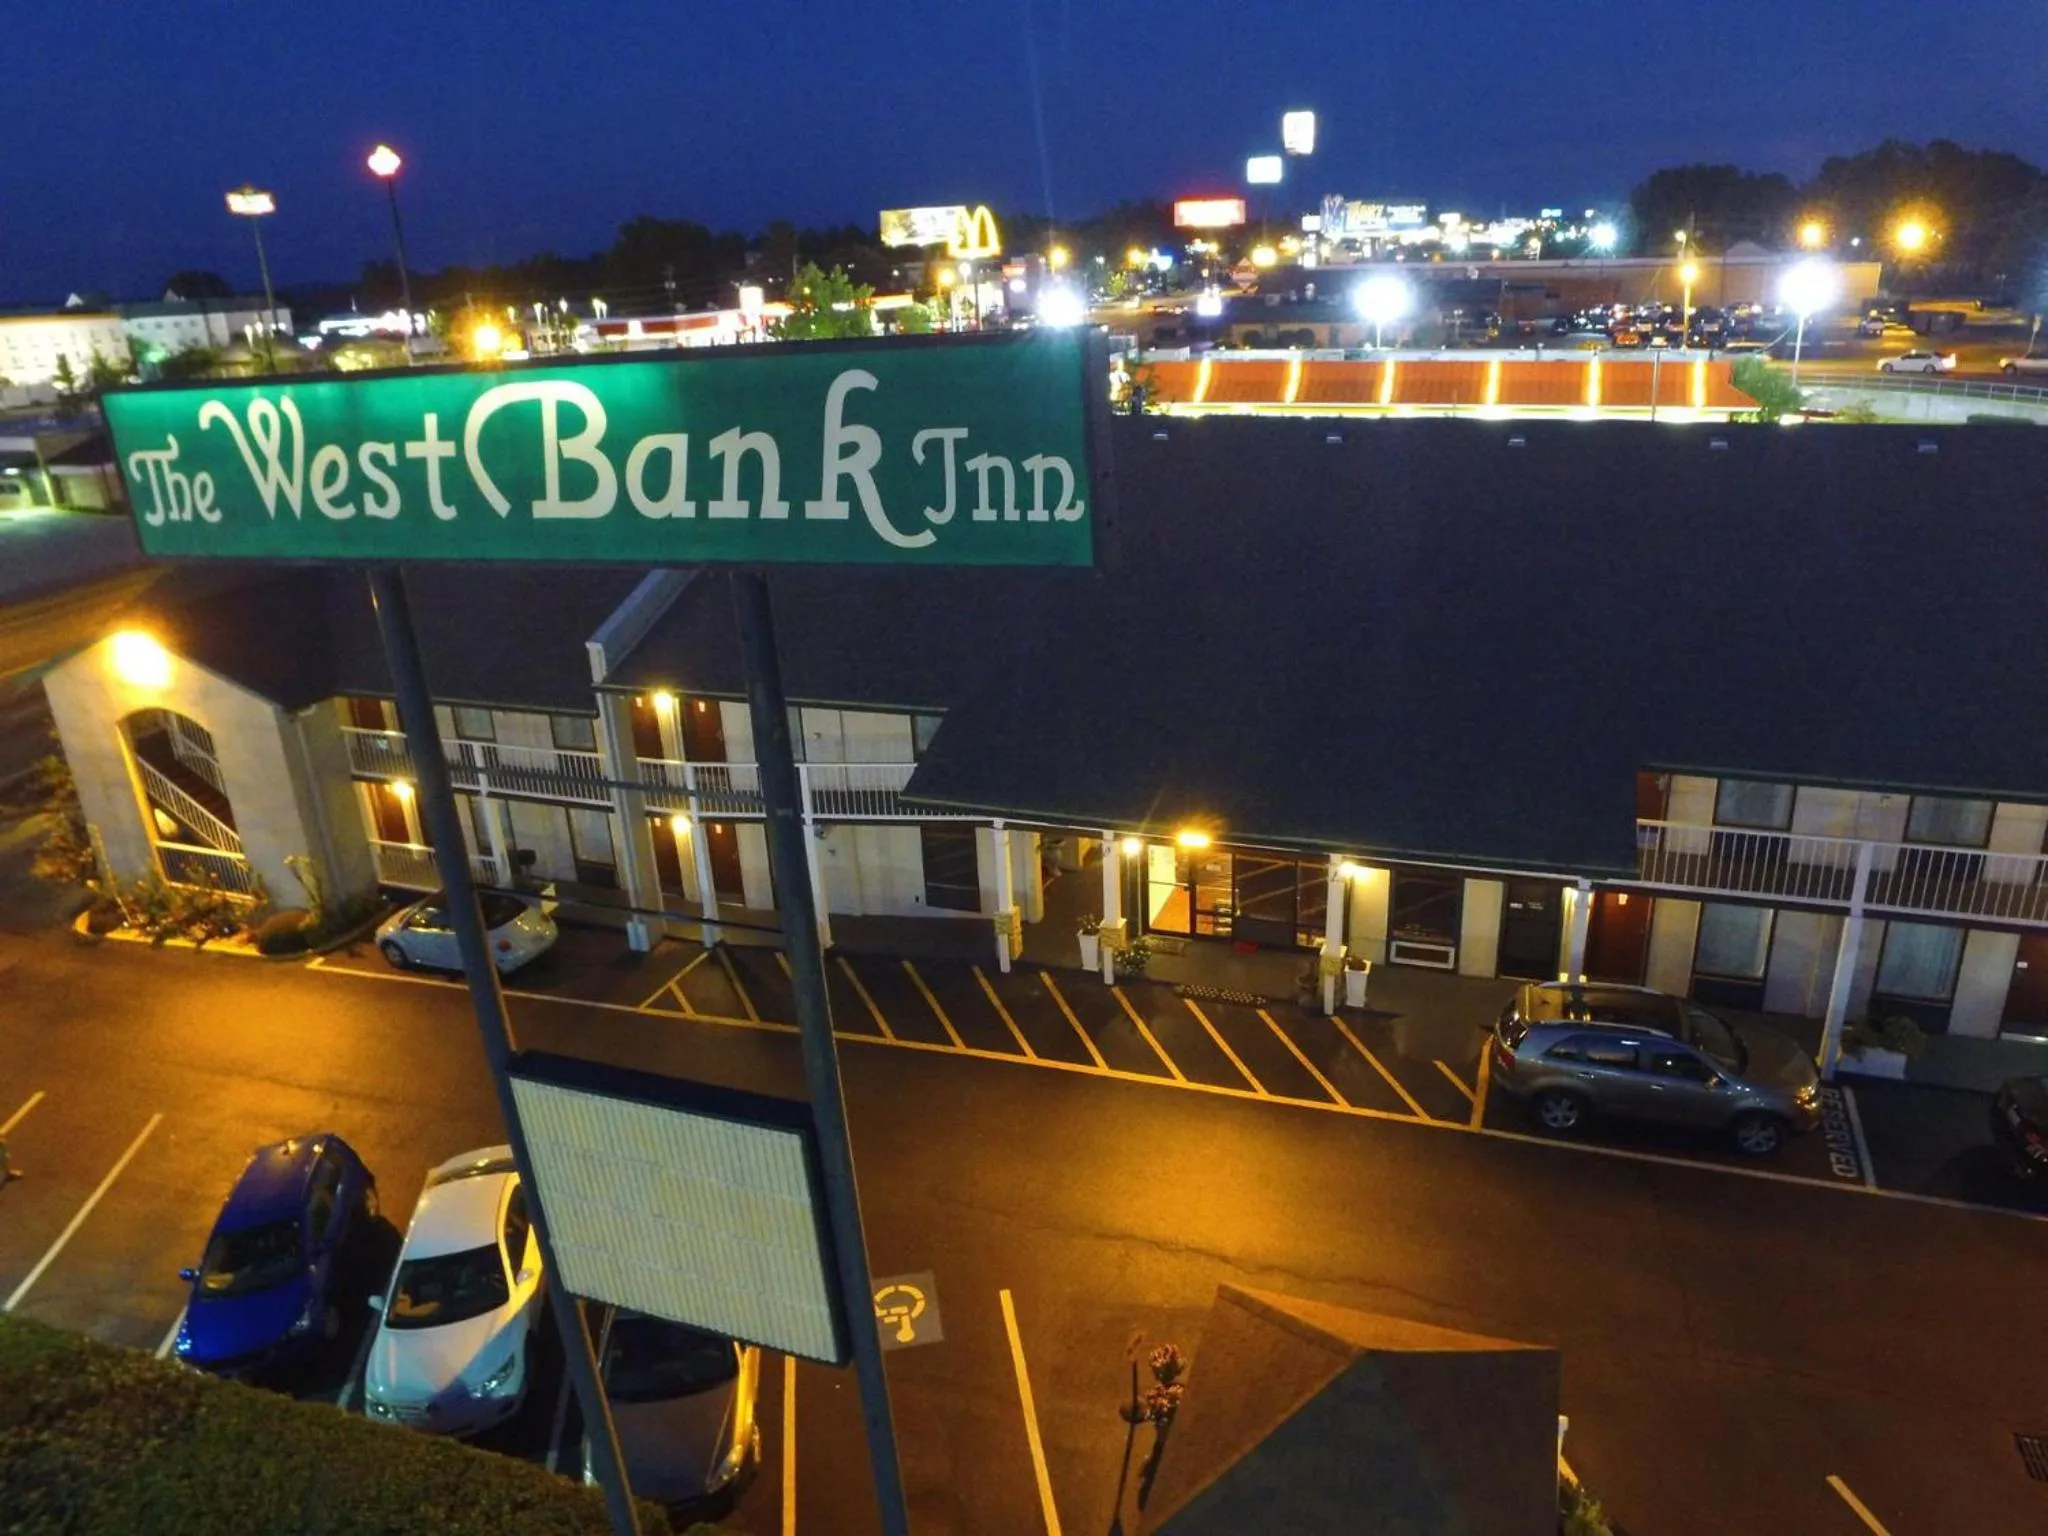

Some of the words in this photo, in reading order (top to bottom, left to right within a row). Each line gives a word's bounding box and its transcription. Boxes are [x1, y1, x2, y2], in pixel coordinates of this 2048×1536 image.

[129, 433, 222, 527] The
[199, 396, 457, 521] West
[464, 368, 938, 549] Bank
[912, 426, 1086, 526] Inn
[1822, 1087, 1859, 1178] RESERVED
